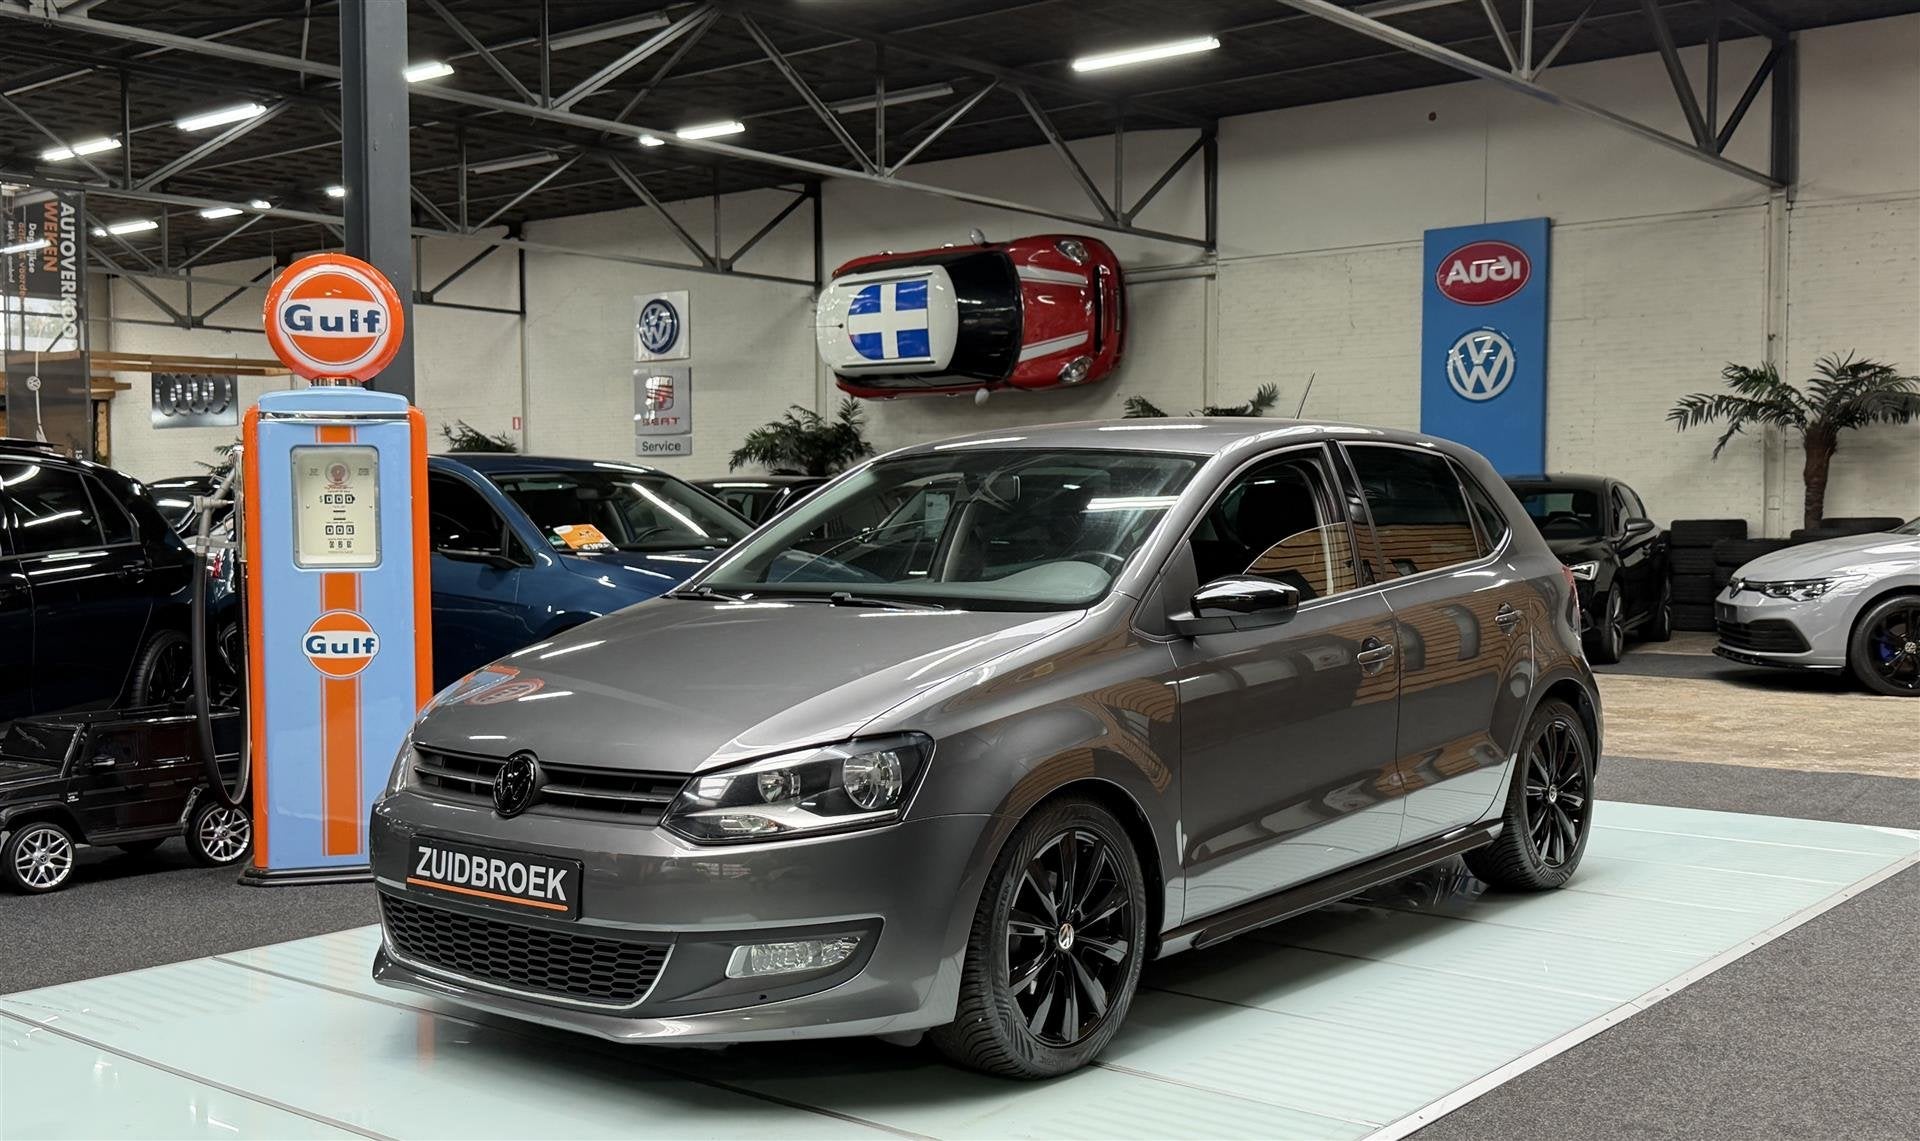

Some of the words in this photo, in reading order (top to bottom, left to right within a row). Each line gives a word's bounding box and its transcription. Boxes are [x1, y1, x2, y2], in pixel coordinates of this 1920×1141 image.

[27, 222, 37, 274] Dagijkse
[43, 201, 58, 272] WEKEN
[60, 201, 79, 345] AUTOVERKOO
[1445, 255, 1521, 286] Audi
[284, 304, 381, 333] Gulf
[642, 416, 681, 427] SEAT
[642, 440, 681, 452] Service
[305, 635, 376, 654] Gulf
[415, 846, 568, 901] ZUIDBROEK
